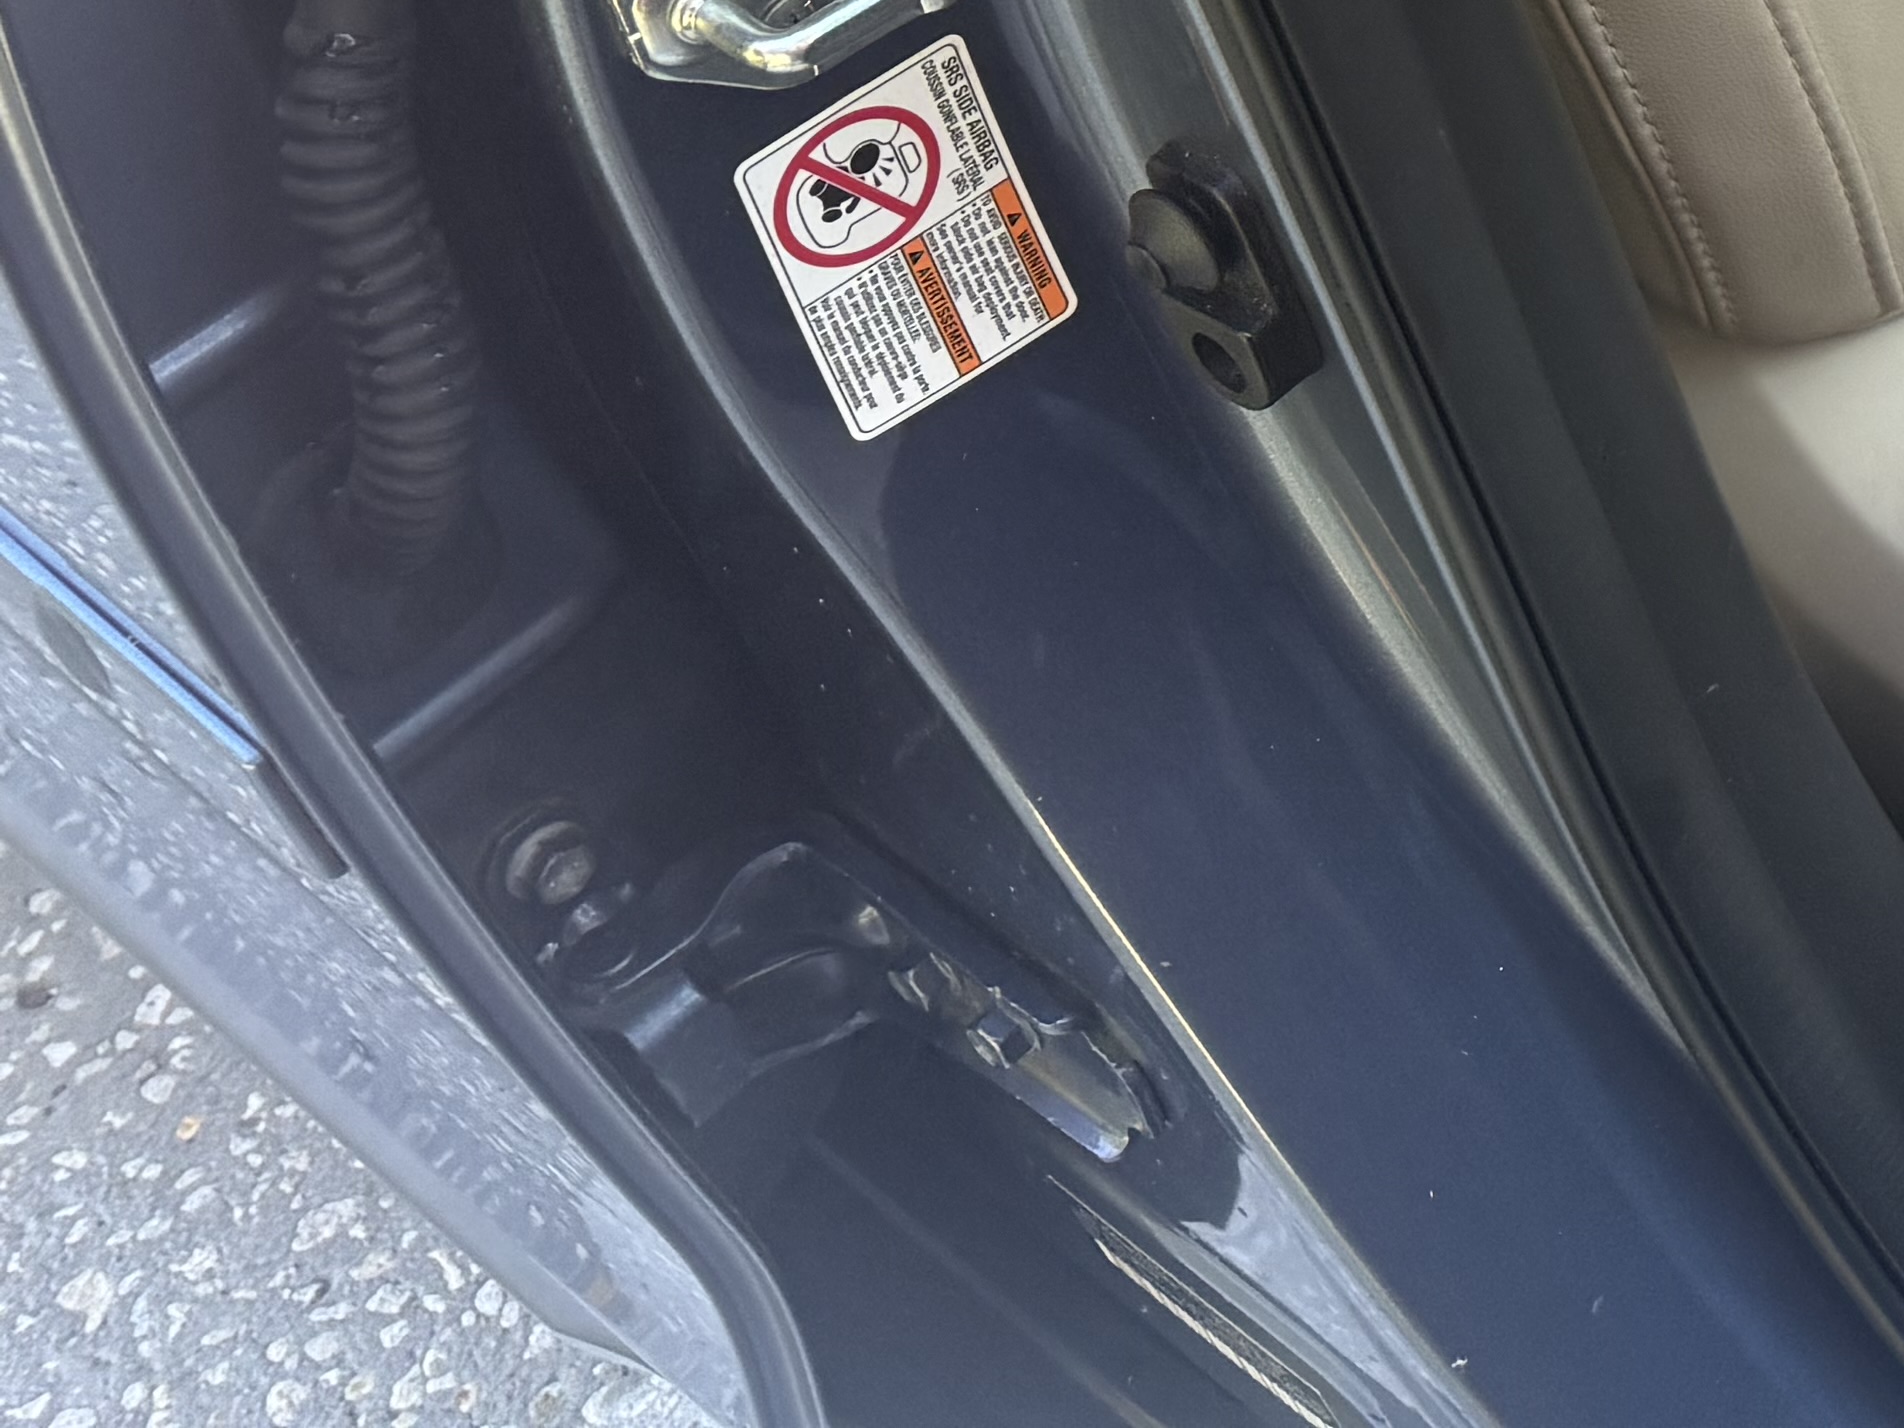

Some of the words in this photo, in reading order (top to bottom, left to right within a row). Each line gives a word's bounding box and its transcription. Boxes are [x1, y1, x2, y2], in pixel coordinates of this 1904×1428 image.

[939, 54, 965, 87] SRS
[918, 58, 947, 102] COUSSIN
[935, 97, 969, 153] GONFLABLE
[958, 147, 987, 191] LATÉRAL
[950, 83, 978, 120] SIDE
[965, 116, 1000, 171] AIRBAG
[1015, 228, 1052, 290] WARNING
[915, 262, 973, 367] AVERTISSEMENT
